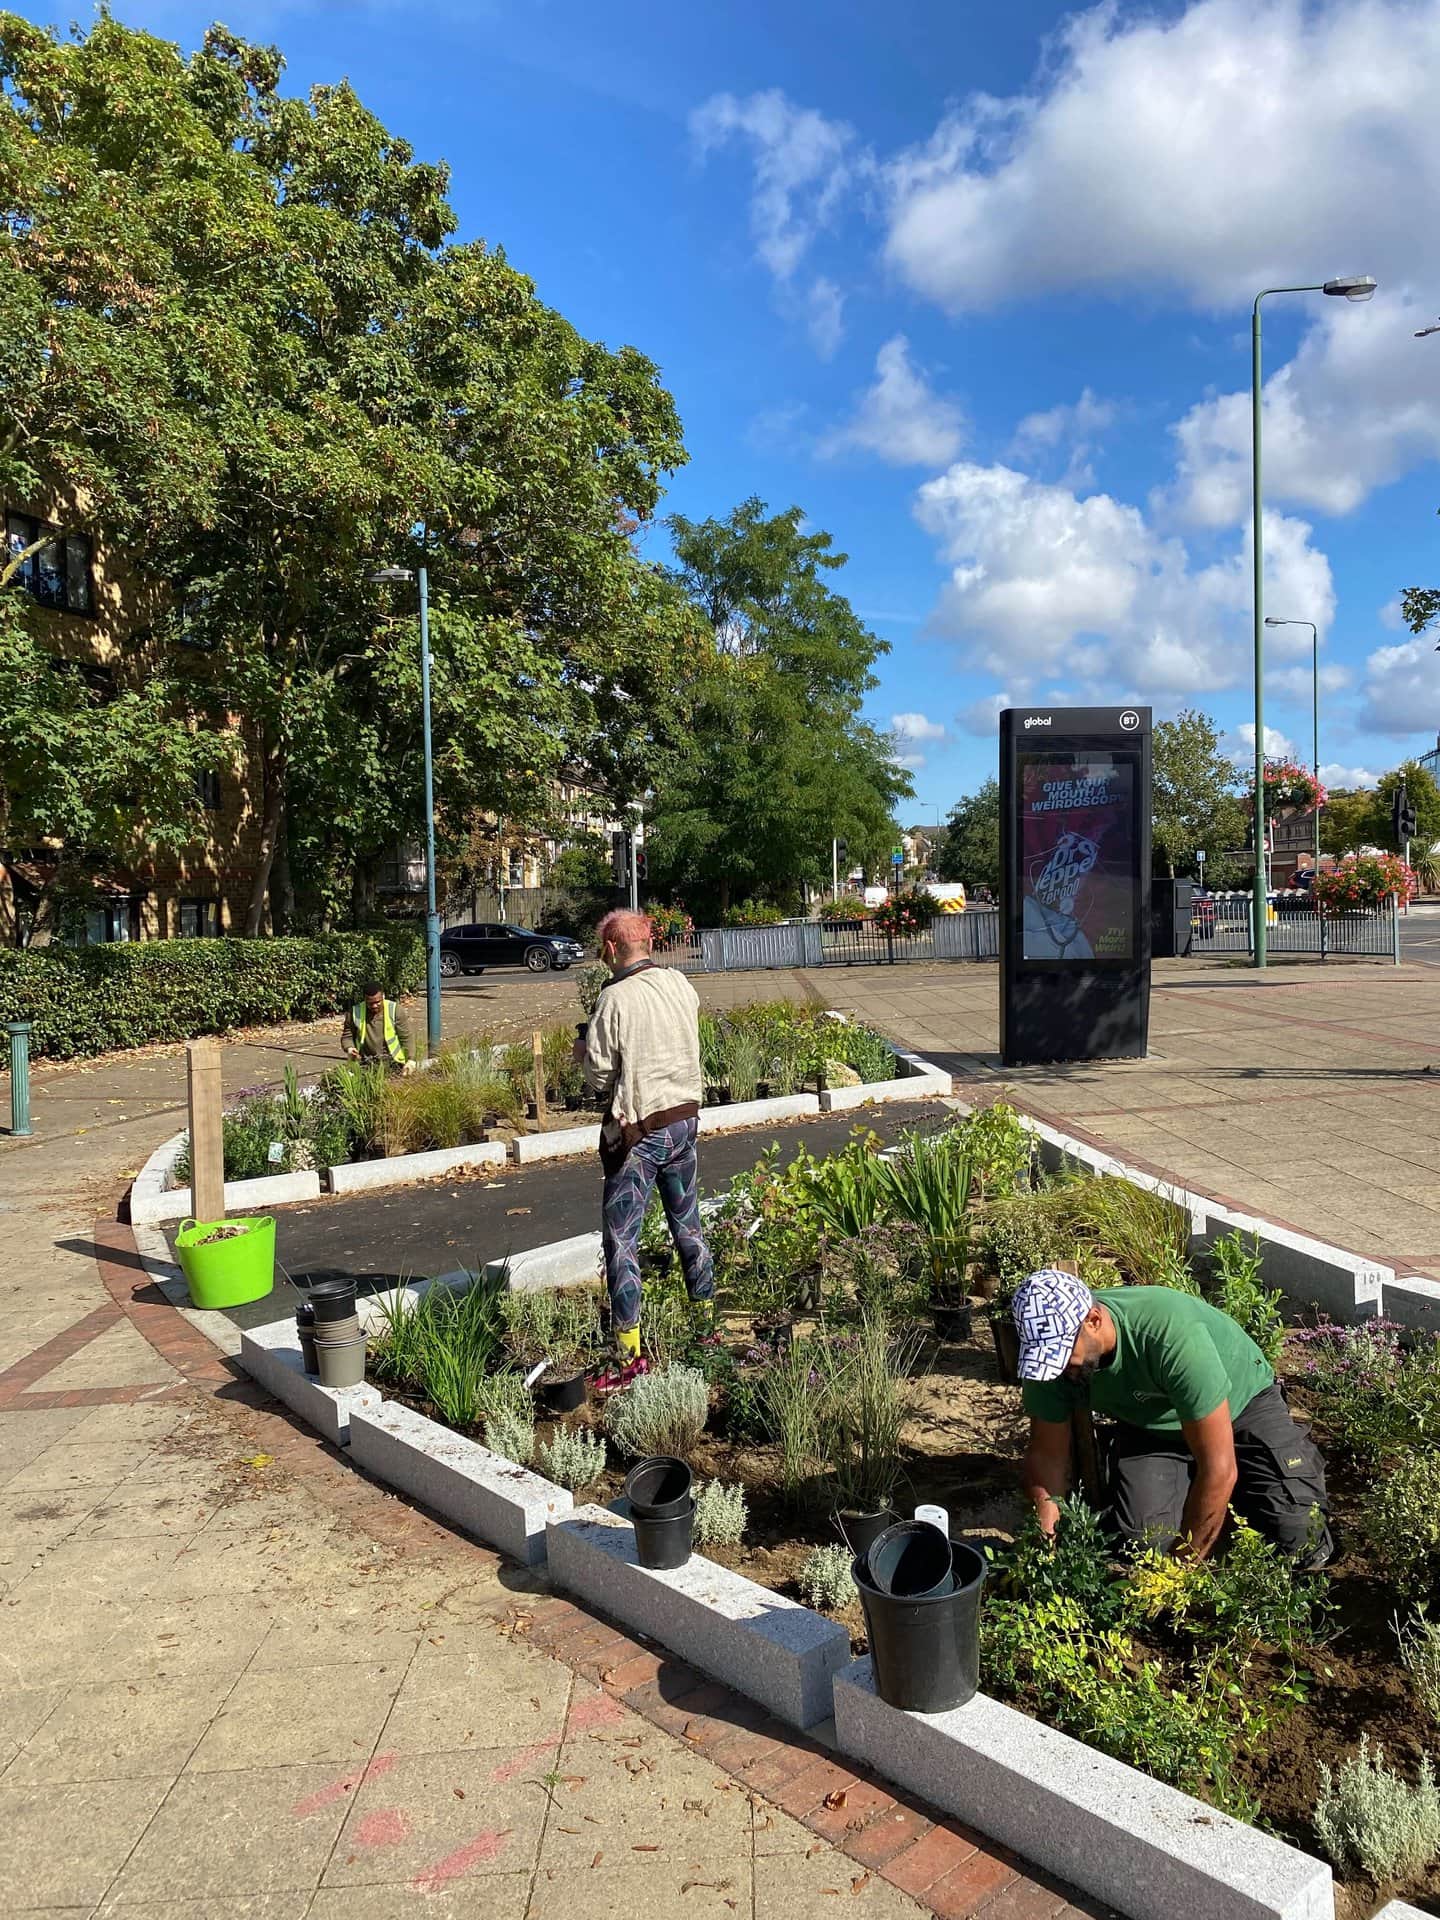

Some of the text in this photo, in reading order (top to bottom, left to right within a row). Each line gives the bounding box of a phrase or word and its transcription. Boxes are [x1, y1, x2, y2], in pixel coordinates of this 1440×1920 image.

[1024, 716, 1052, 729] global
[1123, 716, 1136, 725] BT
[1042, 777, 1111, 793] GIVE YOUR
[1048, 785, 1106, 801] MOUTH A
